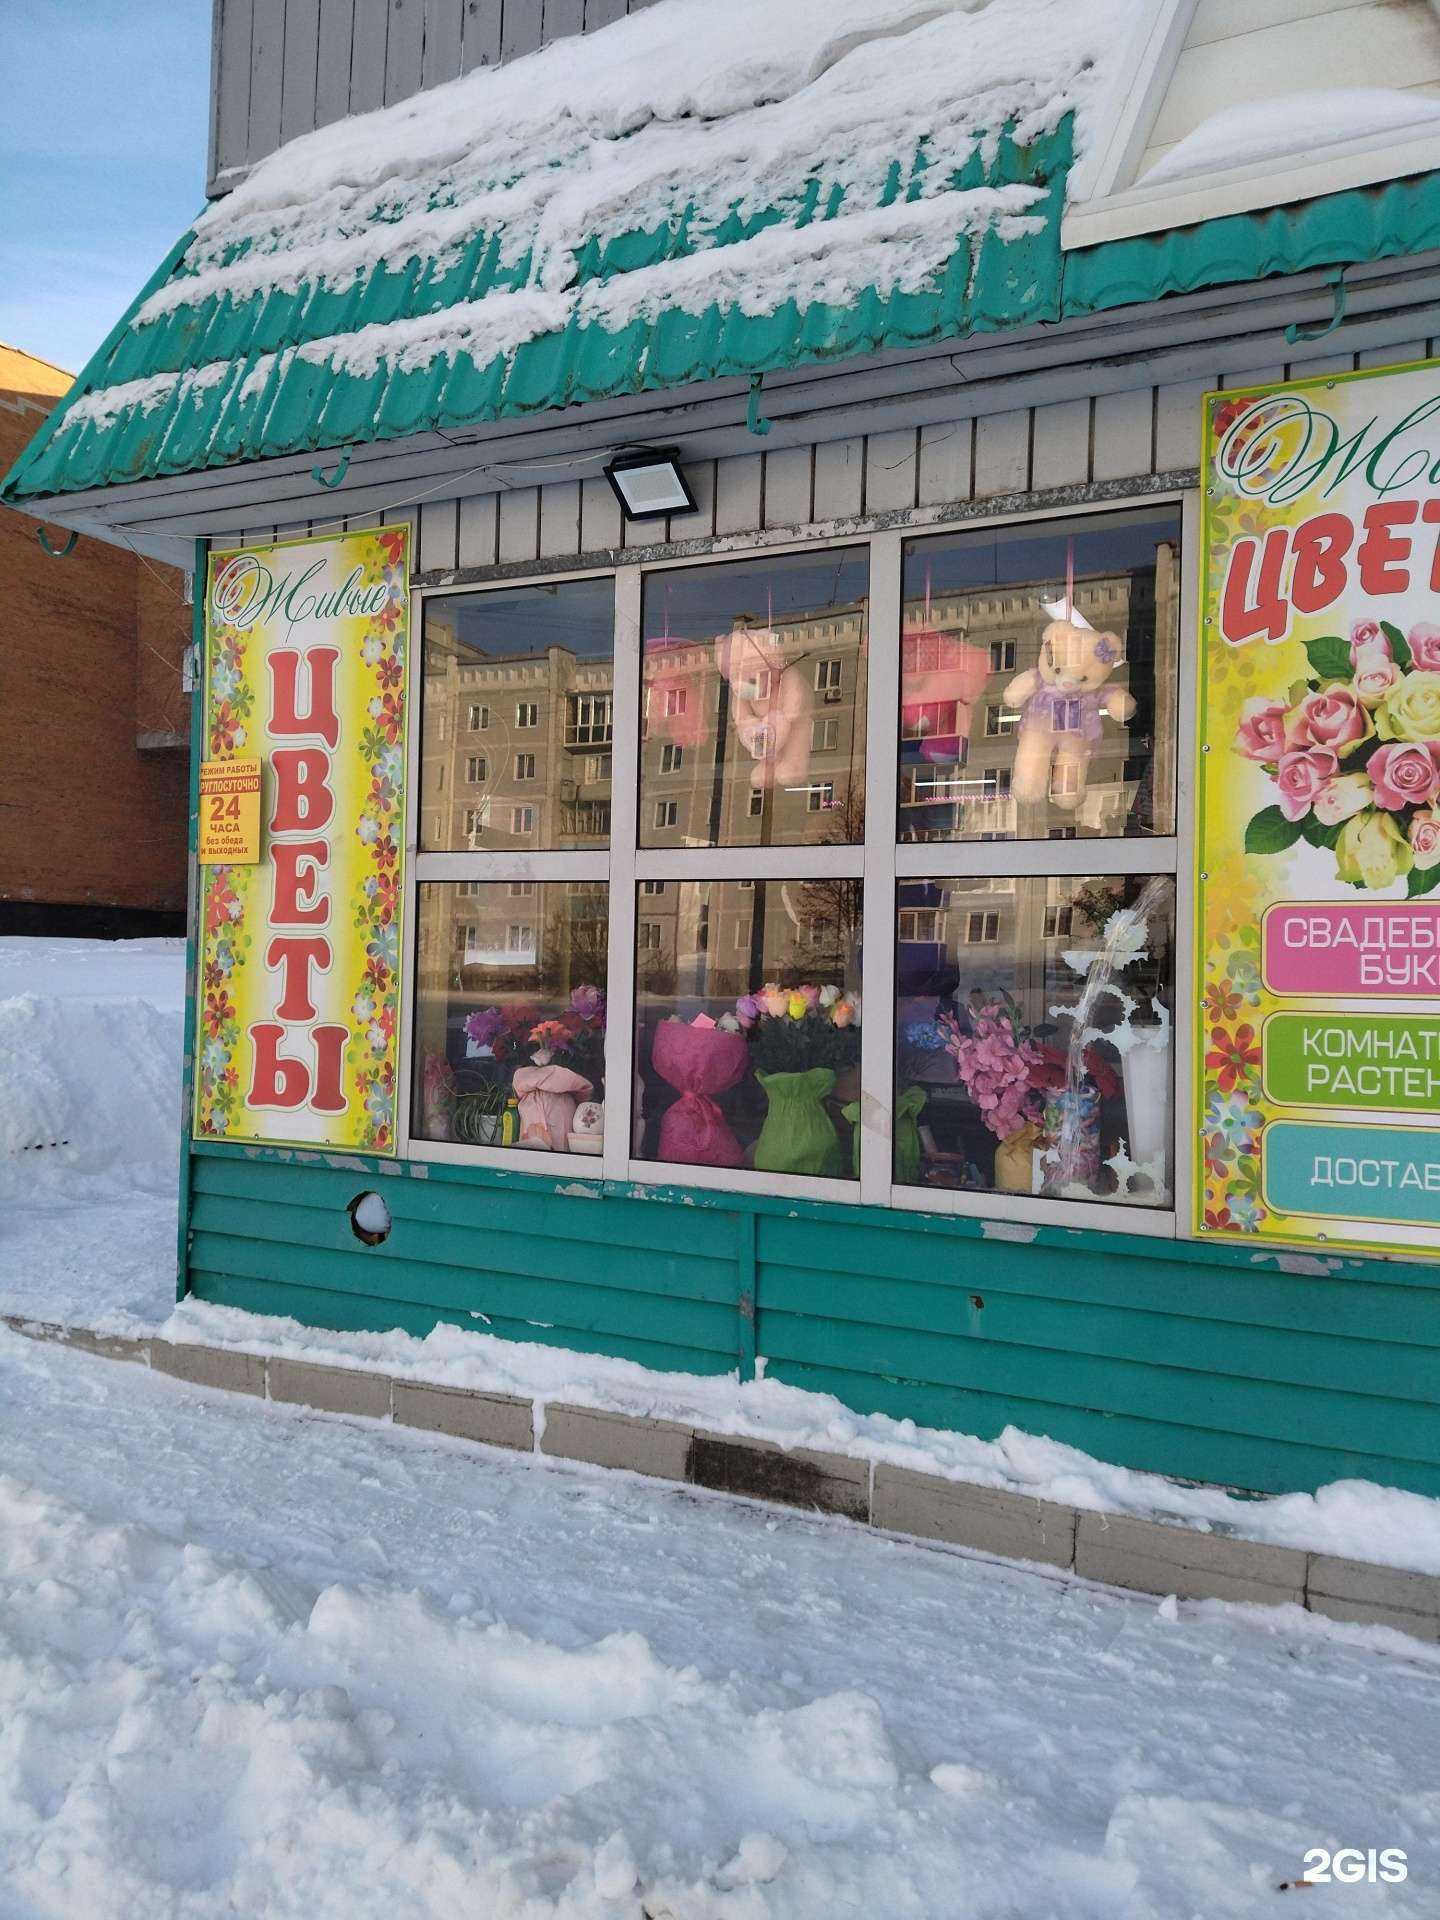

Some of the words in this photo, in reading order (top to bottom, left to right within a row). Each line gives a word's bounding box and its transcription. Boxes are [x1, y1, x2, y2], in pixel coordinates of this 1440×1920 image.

[215, 556, 387, 643] Живые
[226, 764, 257, 774] РАБОТЫ
[210, 795, 241, 821] 24
[206, 836, 219, 844] без
[222, 836, 244, 845] обеда
[210, 823, 240, 833] ЧАСА
[208, 846, 248, 855] выходных
[247, 647, 347, 1112] ЦВЕТЫ
[1284, 916, 1440, 951] СВАДЕБ
[1361, 954, 1440, 985] БУК
[1303, 1028, 1440, 1060] КОМНАТ
